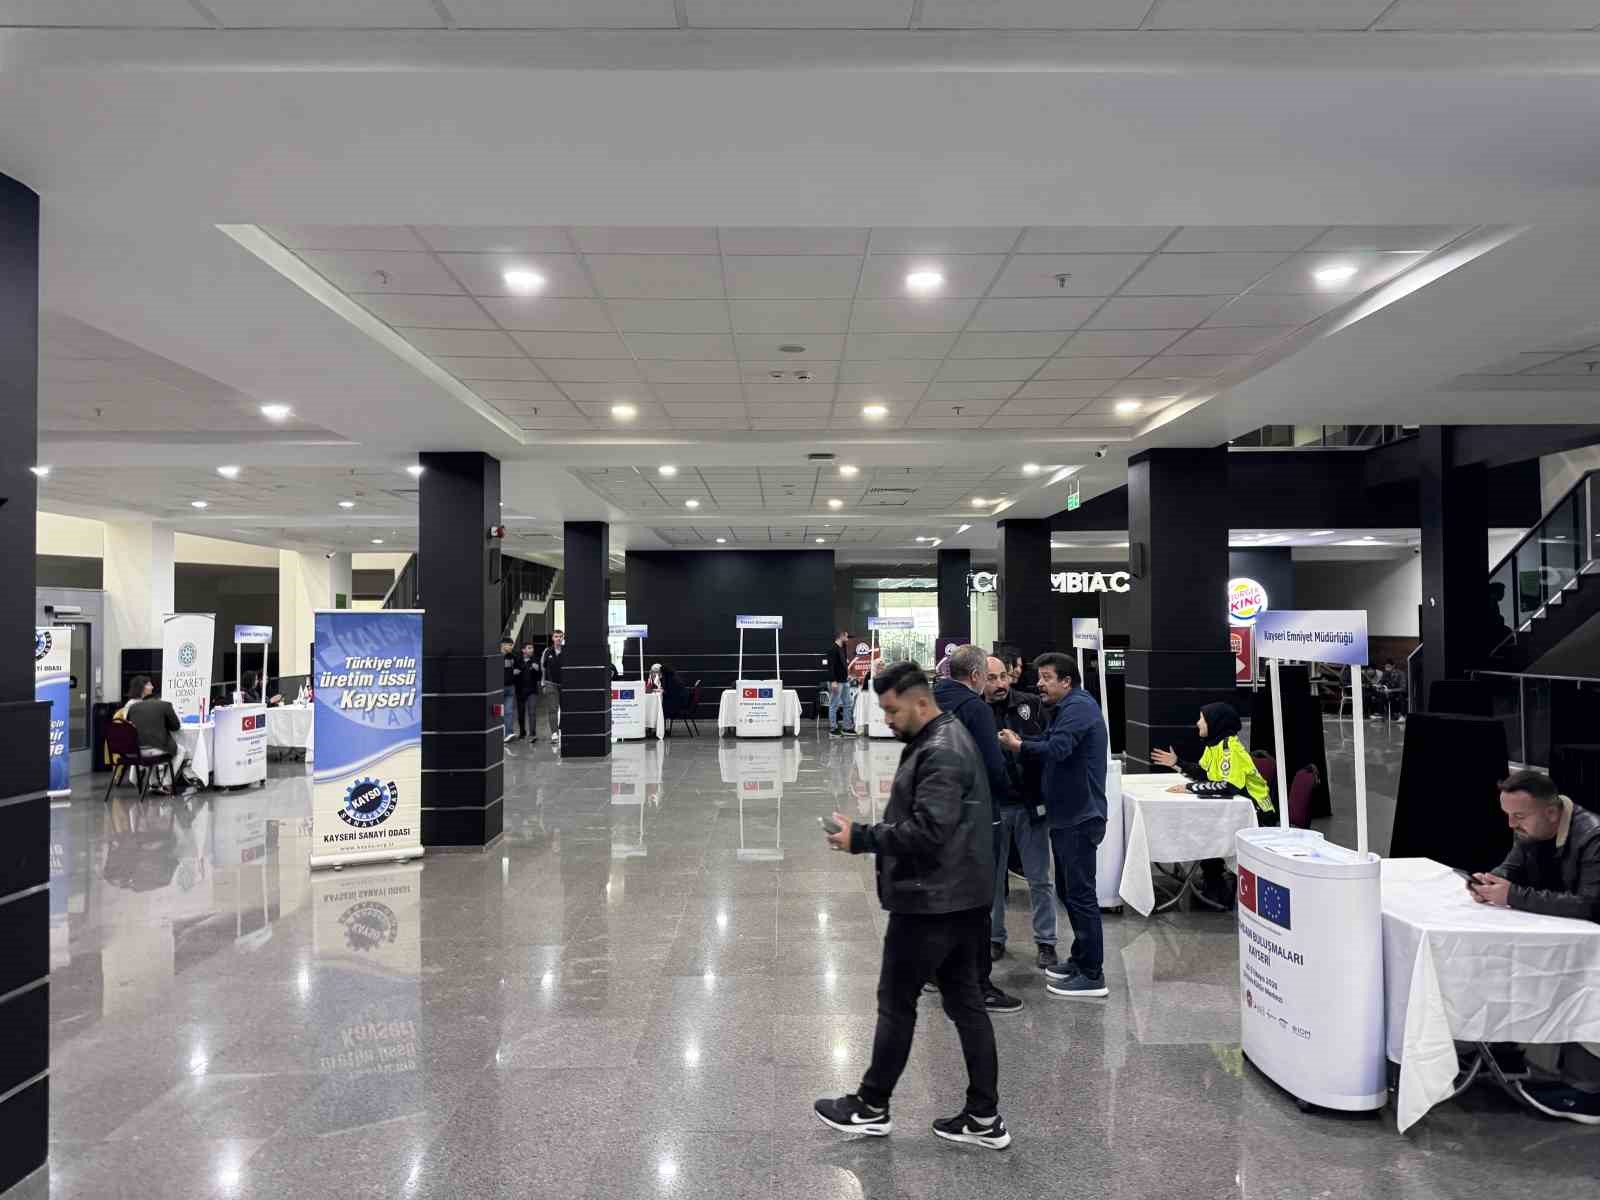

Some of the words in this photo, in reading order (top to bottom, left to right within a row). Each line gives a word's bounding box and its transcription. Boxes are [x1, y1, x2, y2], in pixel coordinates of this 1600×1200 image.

[1231, 594, 1262, 611] KING
[1264, 630, 1286, 644] Kayseri
[1287, 631, 1313, 645] Emniyet
[1314, 631, 1353, 646] Müdürlüğü
[345, 656, 416, 672] Türkiye'nin
[320, 671, 374, 688] üretim
[378, 670, 416, 687] üssü
[340, 688, 417, 712] Kayseri
[351, 786, 382, 810] KAYSO
[323, 831, 357, 843] KAYSERİ
[358, 828, 387, 841] SANAYİ
[388, 827, 411, 838] ODASI
[1248, 943, 1271, 967] KAYSERİ
[1252, 933, 1304, 967] BULUŞMALARI
